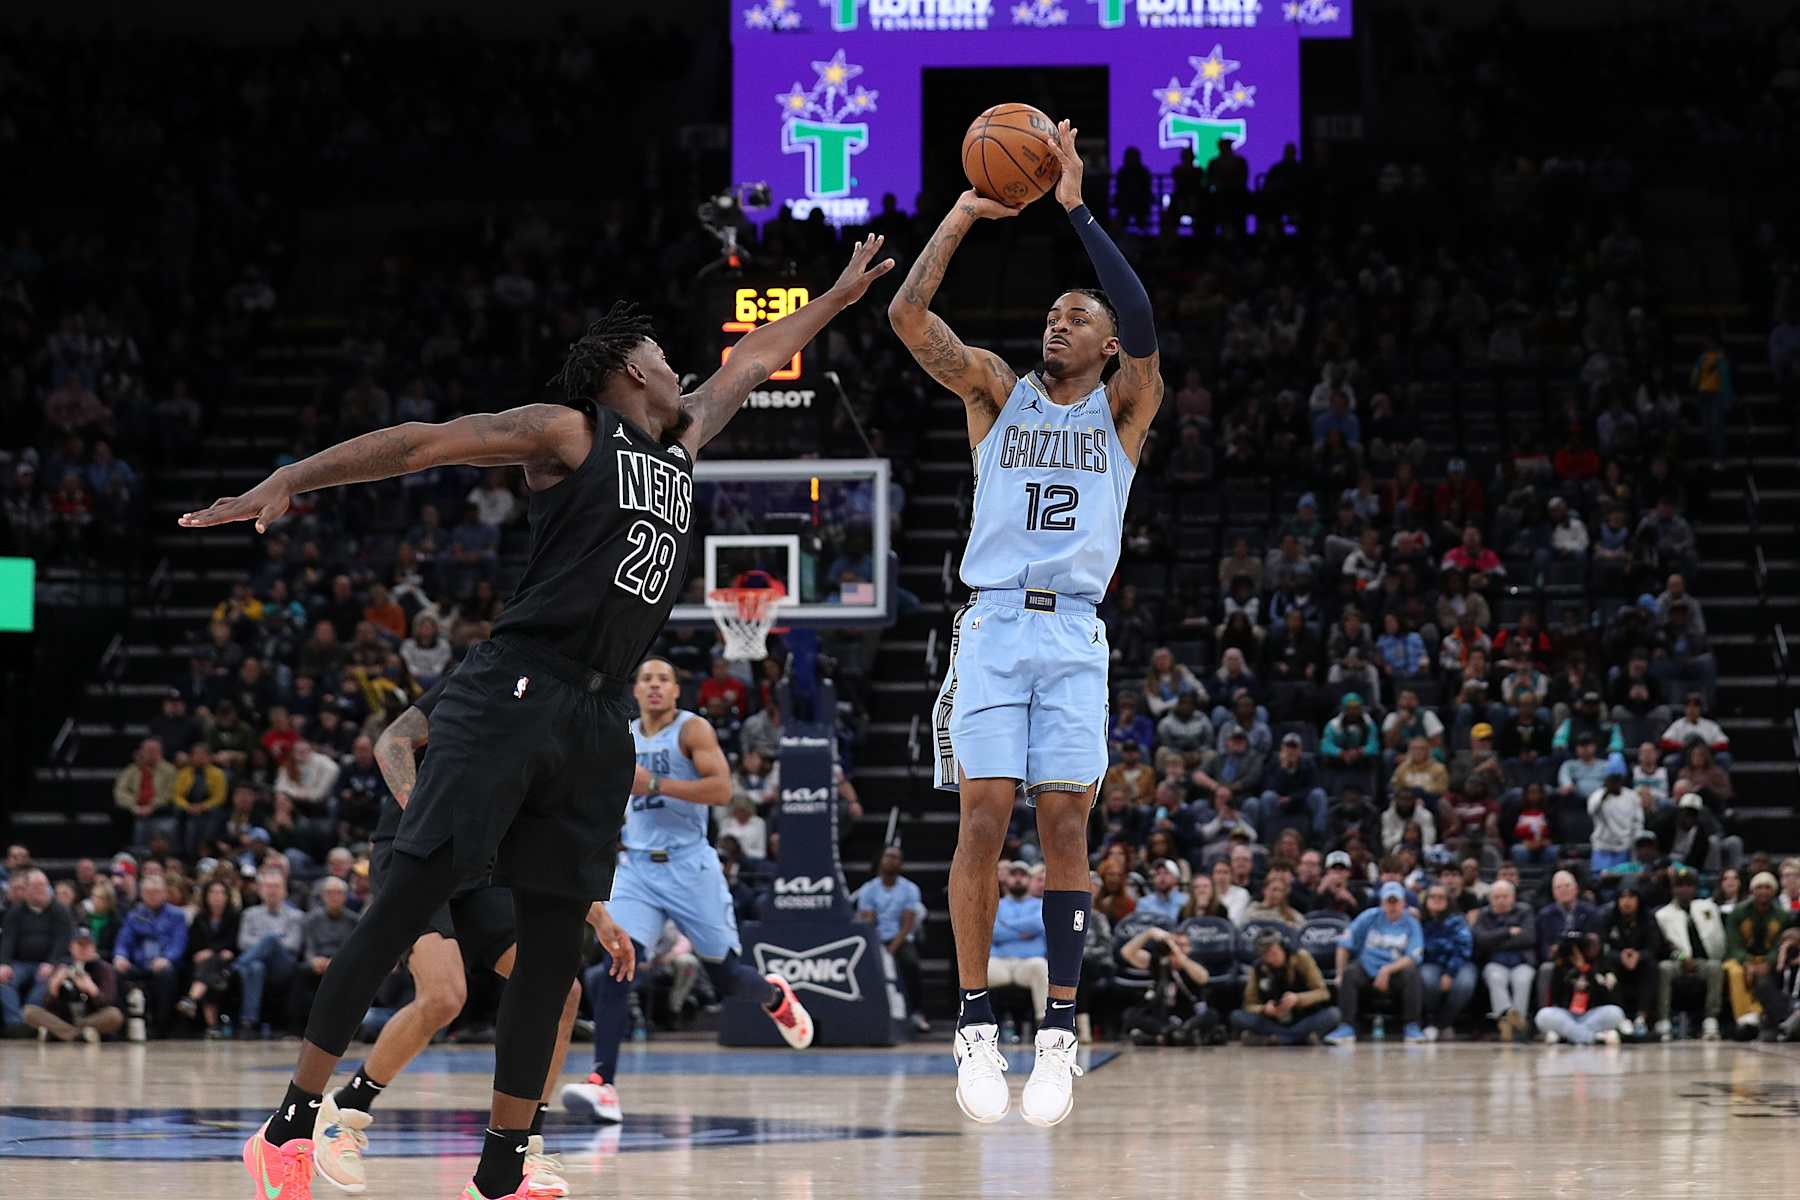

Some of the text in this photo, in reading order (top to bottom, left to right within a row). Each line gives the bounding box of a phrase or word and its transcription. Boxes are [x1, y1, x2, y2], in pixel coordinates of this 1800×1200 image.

[735, 287, 809, 322] 6:30
[1000, 425, 1107, 474] GRIZZLIES
[616, 450, 693, 534] NETS
[1025, 482, 1079, 531] 12
[614, 520, 676, 604] 28
[766, 958, 848, 982] SONIC
